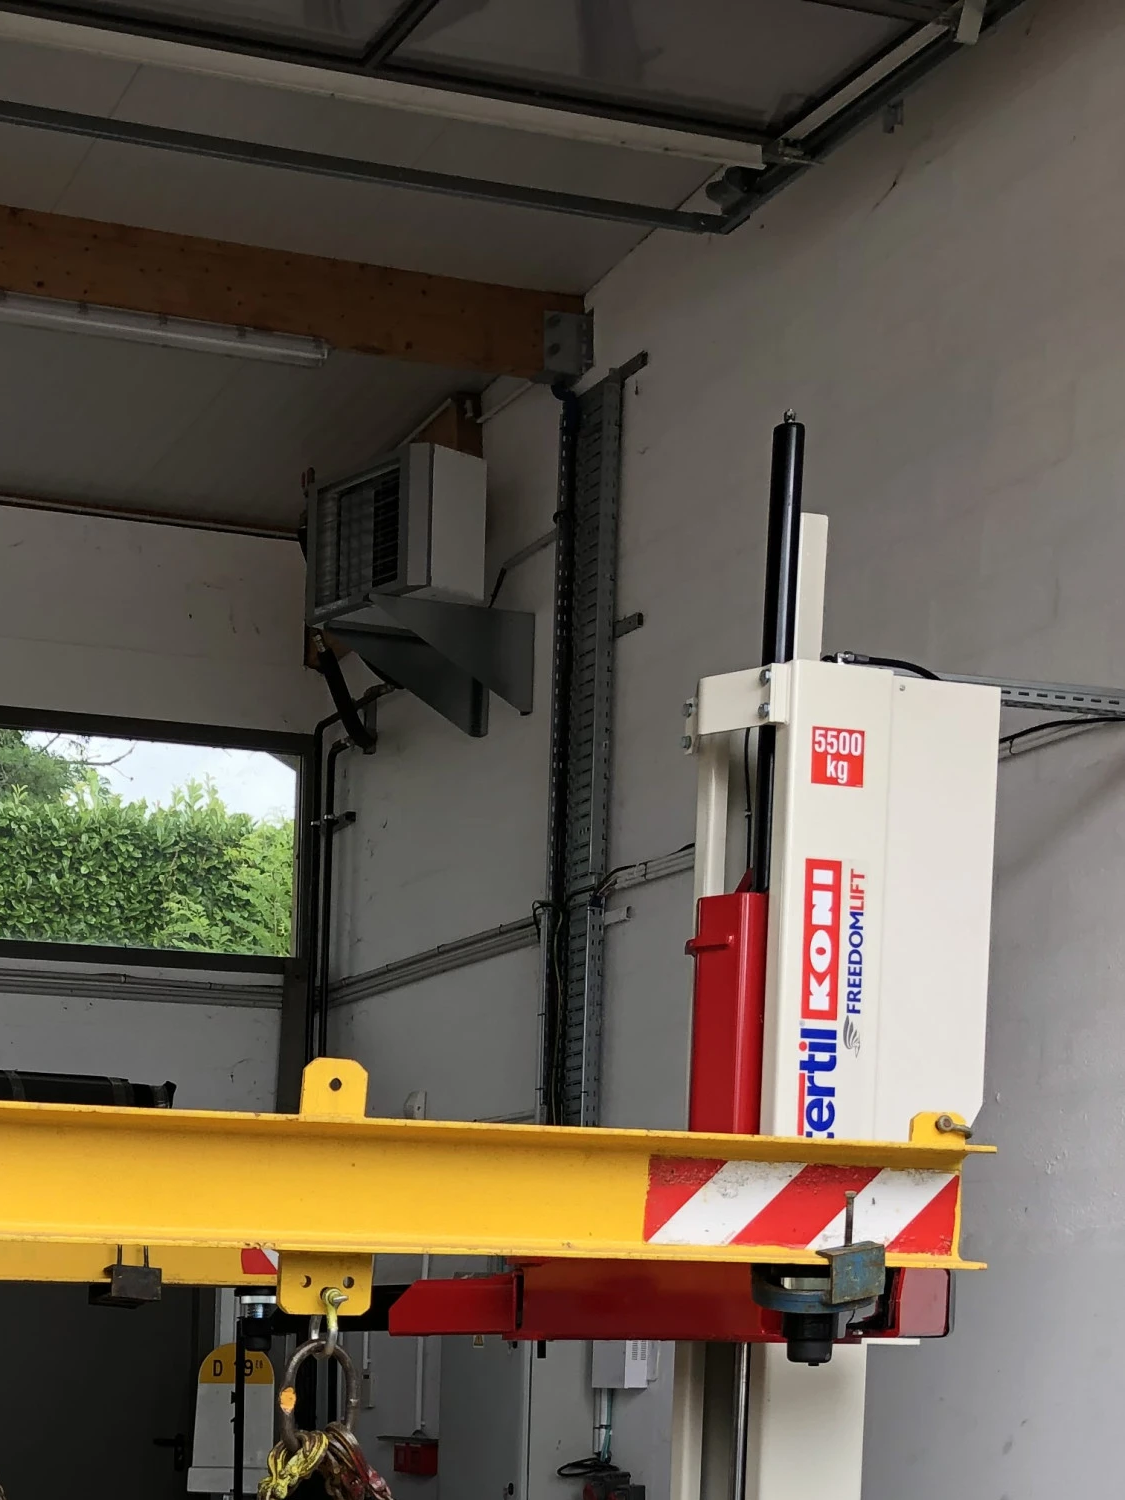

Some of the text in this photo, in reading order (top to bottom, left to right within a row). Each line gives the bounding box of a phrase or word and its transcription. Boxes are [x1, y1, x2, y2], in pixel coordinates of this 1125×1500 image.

[814, 729, 862, 756] 5500
[826, 754, 848, 784] kg
[846, 868, 865, 1014] FREEDOMLIFT
[797, 868, 837, 1139] ertil KONI
[213, 1359, 224, 1377] D
